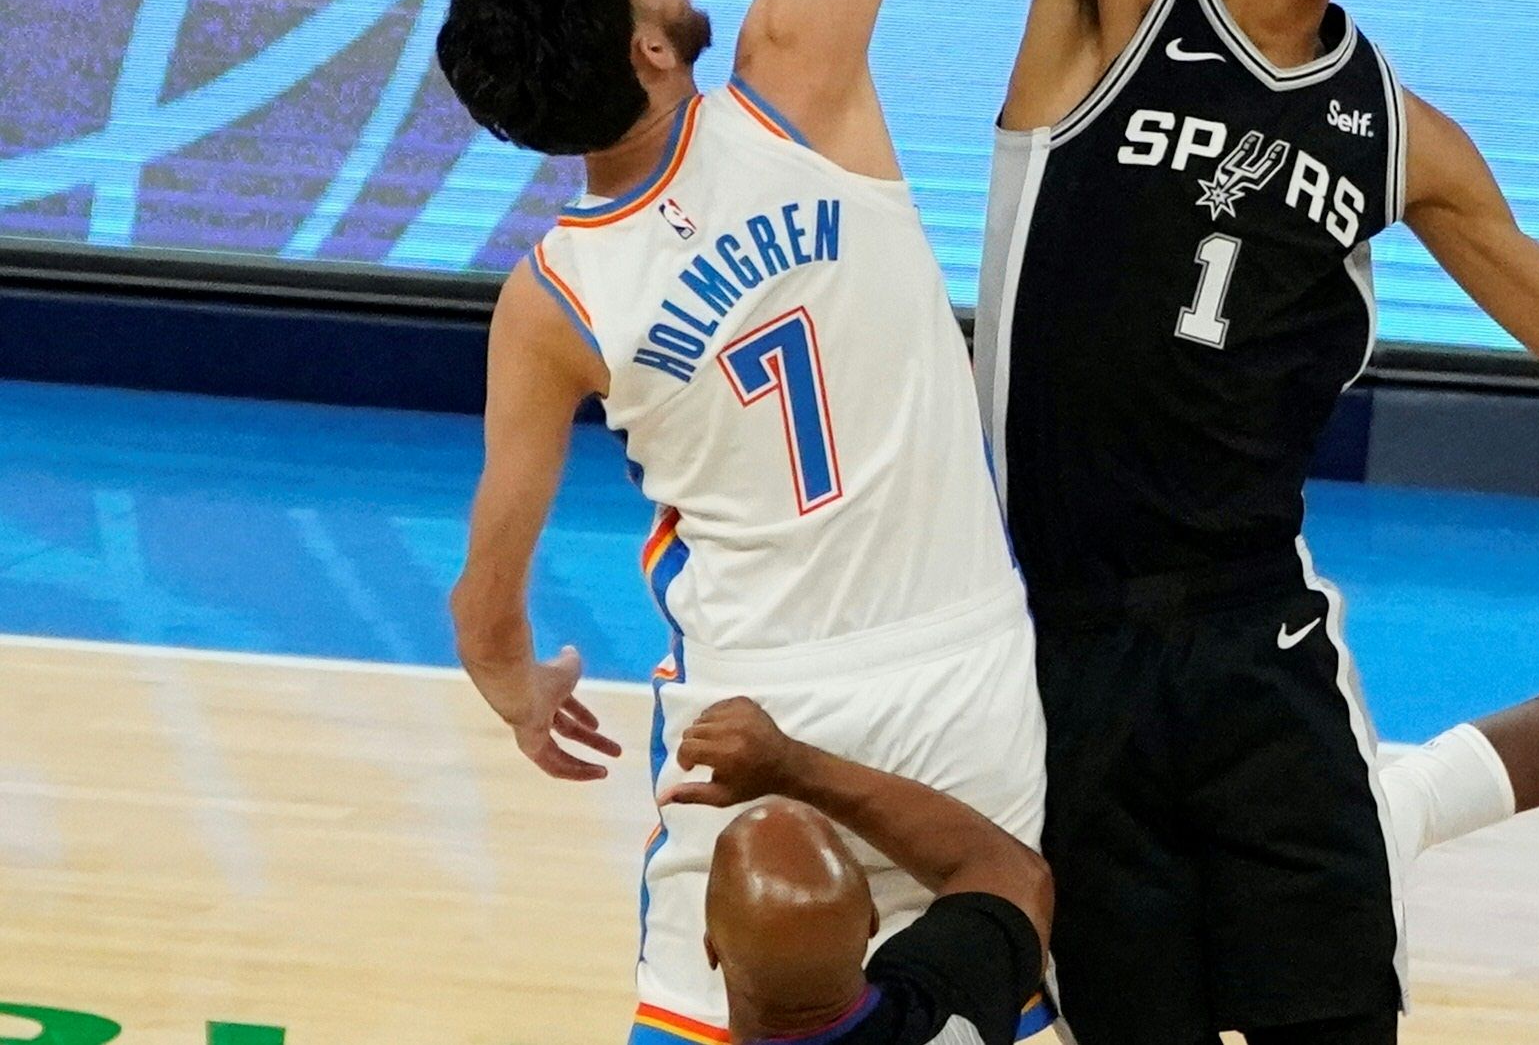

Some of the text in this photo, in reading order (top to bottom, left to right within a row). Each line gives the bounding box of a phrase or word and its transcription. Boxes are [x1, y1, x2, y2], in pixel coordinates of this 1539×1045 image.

[1117, 109, 1365, 248] SPURS
[633, 200, 840, 383] HOLMGREN
[1174, 232, 1242, 350] 1
[716, 305, 844, 516] 7
